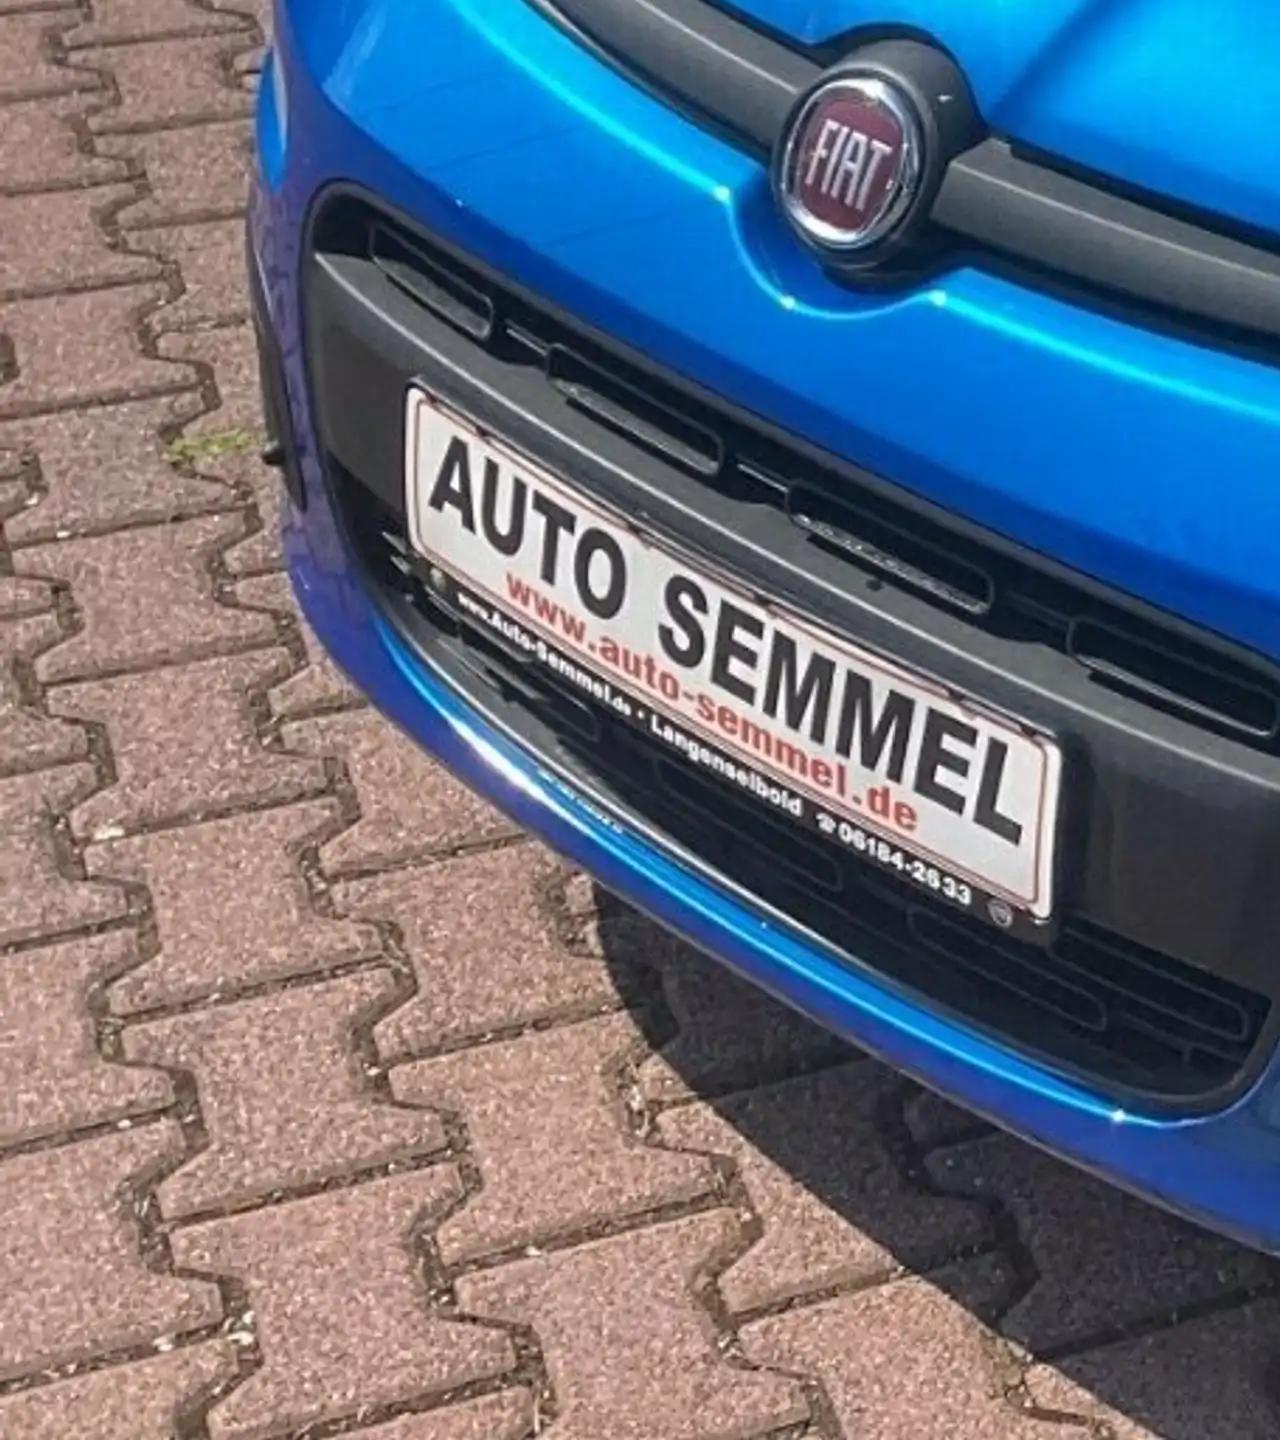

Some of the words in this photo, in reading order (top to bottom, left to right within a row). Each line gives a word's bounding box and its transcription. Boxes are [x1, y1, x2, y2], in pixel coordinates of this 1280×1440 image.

[804, 118, 893, 212] FIAT
[428, 436, 626, 620] AUTO
[657, 572, 1023, 846] SEMMEL
[504, 569, 919, 833] www.auto-semmel.de
[651, 713, 803, 818] Langenselbold
